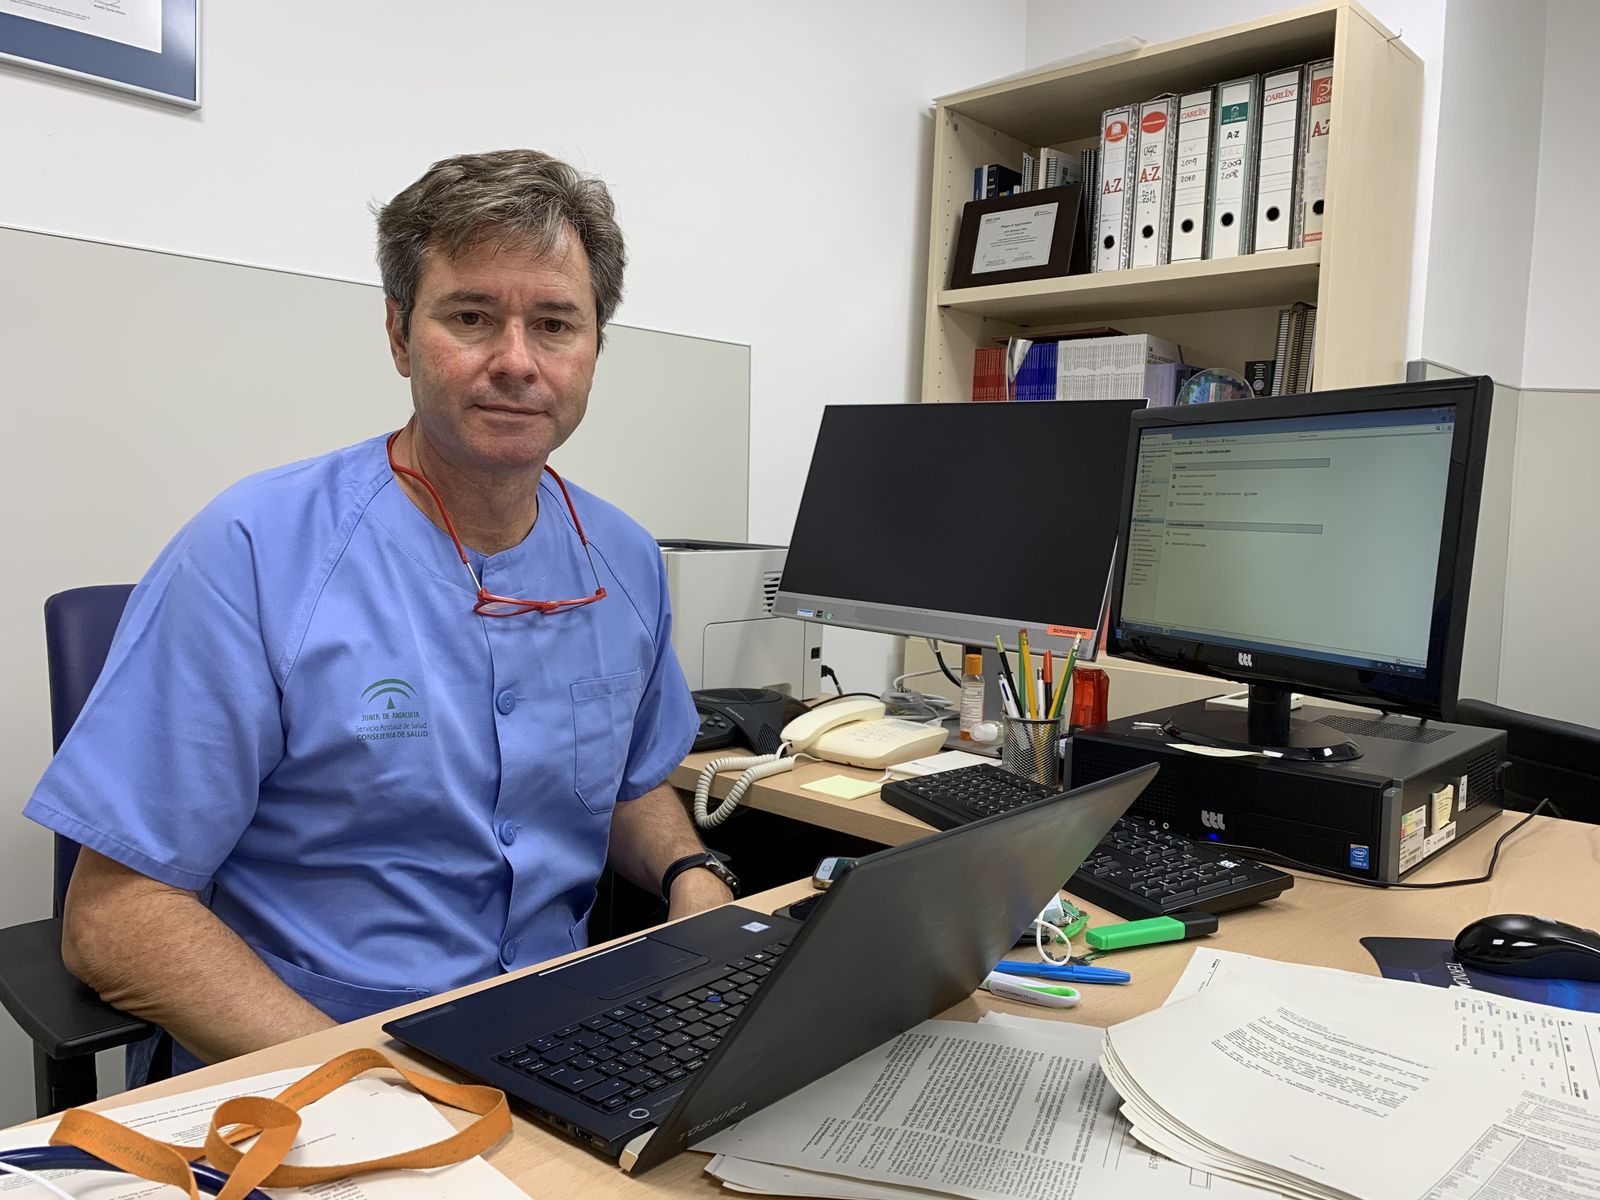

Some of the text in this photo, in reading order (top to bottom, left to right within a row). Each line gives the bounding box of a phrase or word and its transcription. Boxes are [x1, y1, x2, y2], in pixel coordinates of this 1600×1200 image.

[1227, 130, 1240, 140] A-Z
[1139, 165, 1162, 184] A-Z
[1103, 177, 1123, 195] A-Z
[382, 712, 389, 720] DE
[355, 724, 379, 733] Servicio
[402, 721, 410, 730] de
[411, 720, 428, 729] Salud
[397, 730, 406, 739] DE
[406, 730, 429, 738] SALUD
